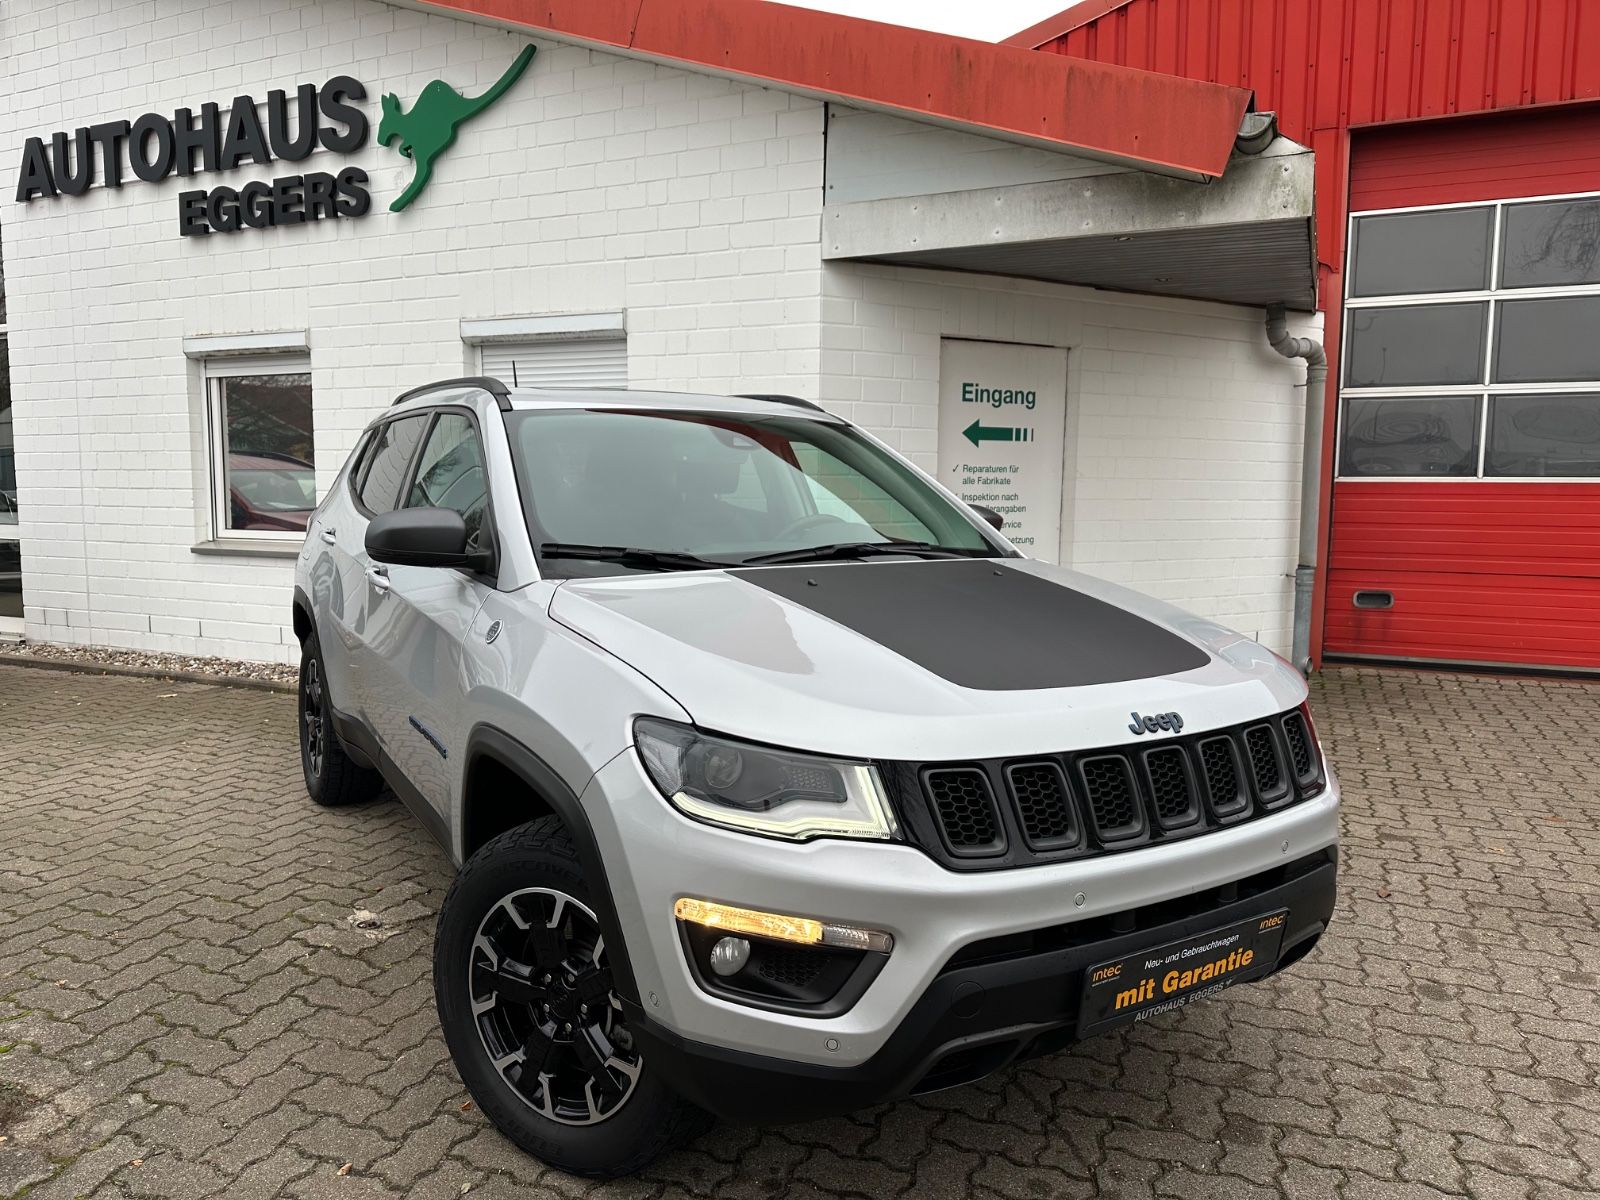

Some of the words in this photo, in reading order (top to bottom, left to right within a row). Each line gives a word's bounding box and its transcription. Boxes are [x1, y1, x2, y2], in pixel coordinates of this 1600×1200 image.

[16, 75, 369, 202] AUTOHAUS
[179, 166, 371, 236] EGGERS
[962, 382, 1036, 410] Eingang
[962, 464, 1008, 474] Reparaturen
[1009, 464, 1020, 473] für
[962, 477, 975, 485] alle
[977, 476, 1011, 485] Fabrikate
[962, 493, 1000, 502] Inspektion
[1001, 493, 1018, 501] nach
[1128, 711, 1184, 736] Jeep
[1144, 959, 1164, 970] Neu-
[1165, 952, 1180, 964] und
[1181, 934, 1240, 959] Gebrauchtwagen
[1114, 979, 1156, 1010] mit
[1162, 947, 1254, 994] Garantie
[1134, 997, 1186, 1023] AUTOHAUS
[1188, 982, 1225, 1003] EGGERS
